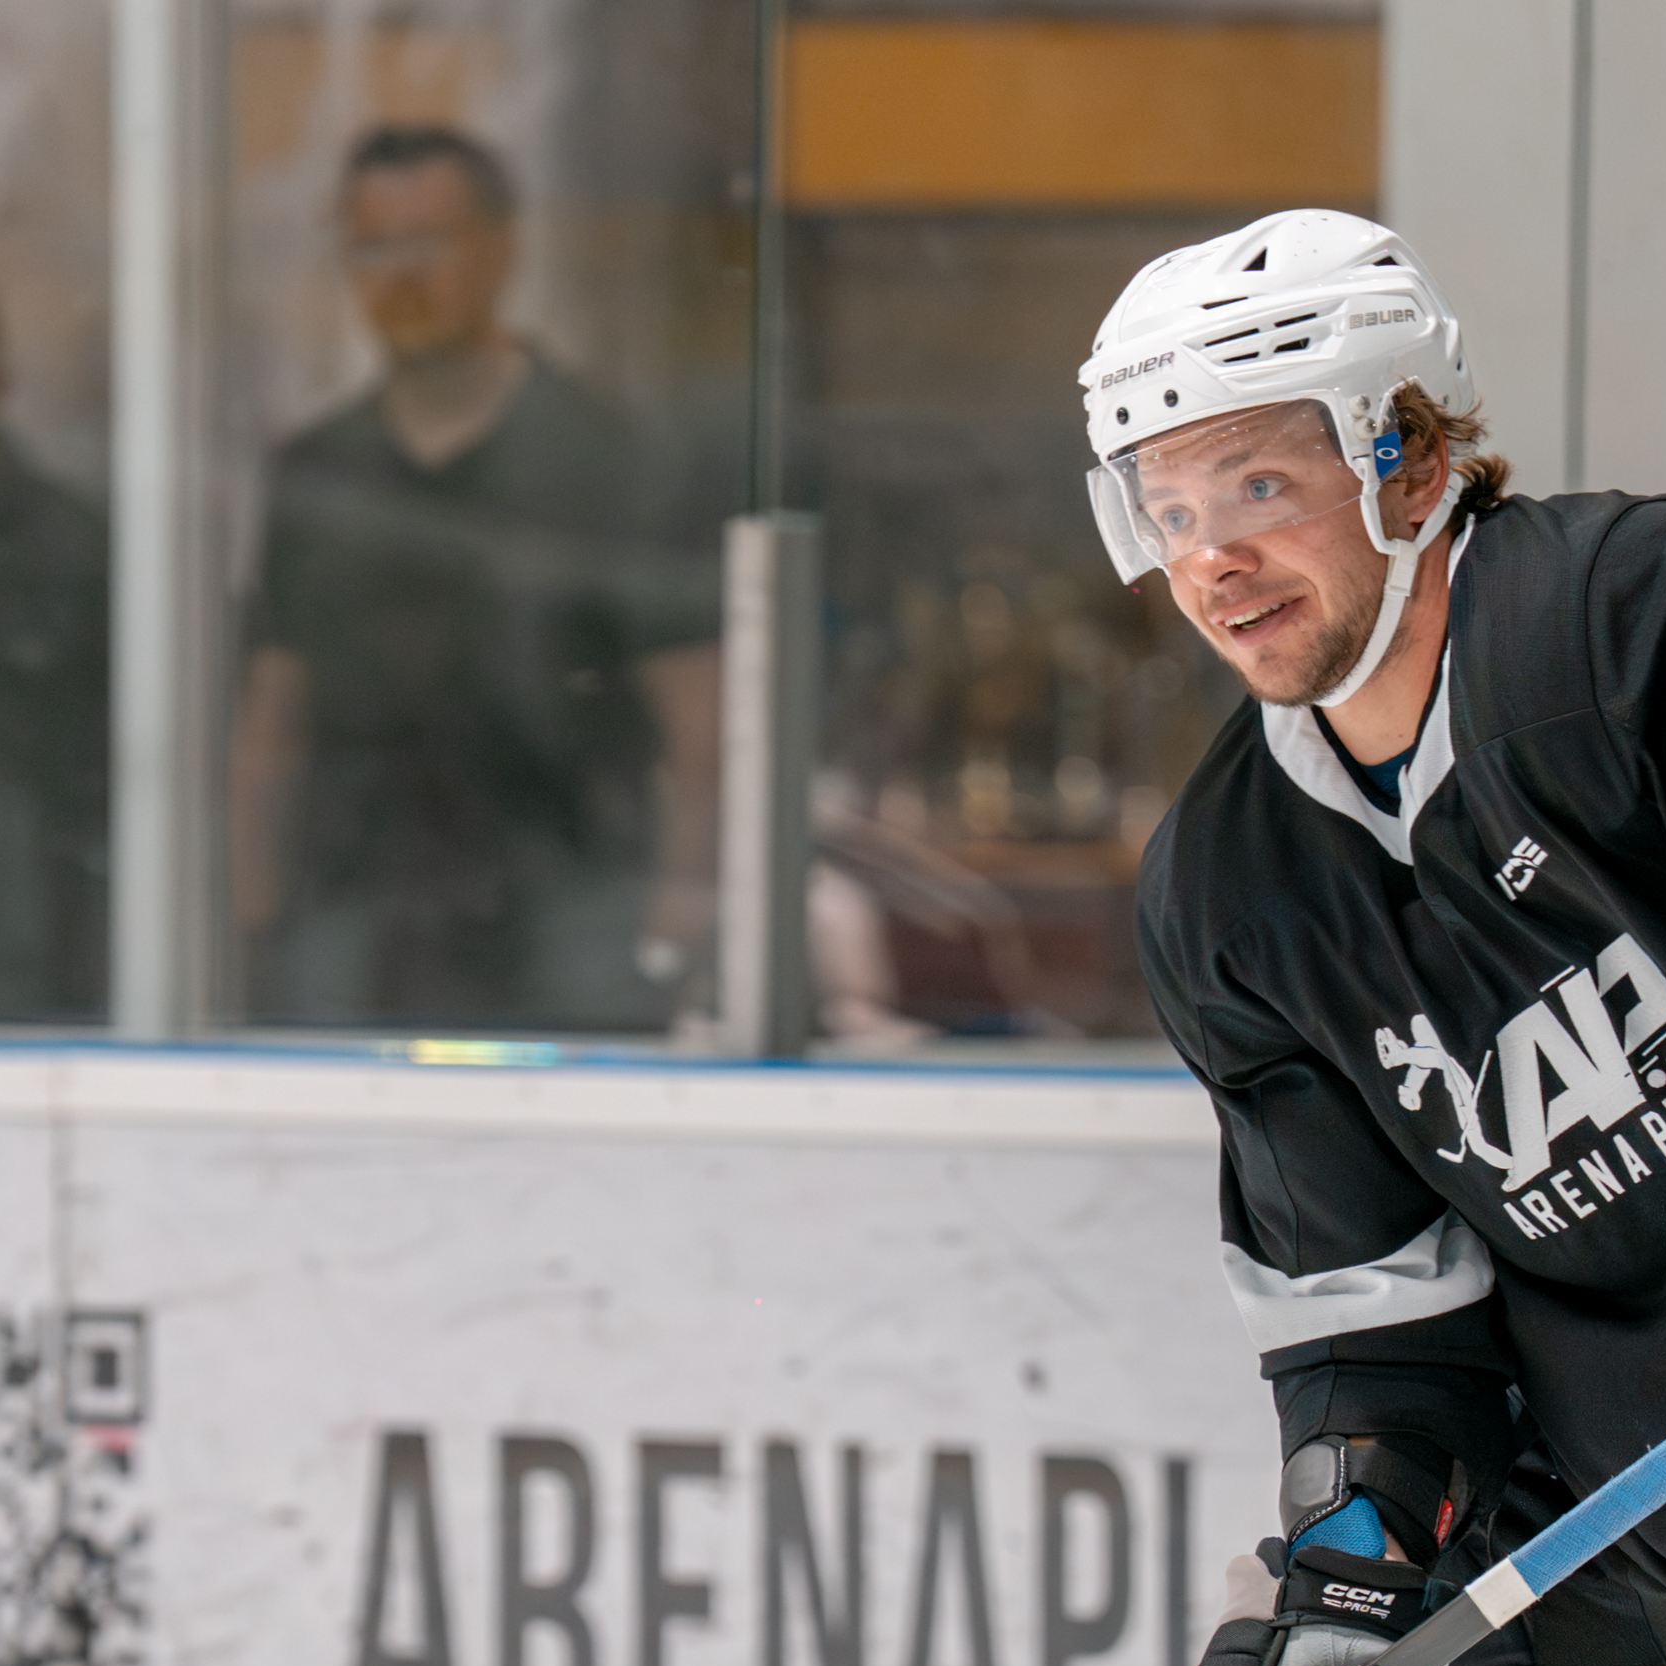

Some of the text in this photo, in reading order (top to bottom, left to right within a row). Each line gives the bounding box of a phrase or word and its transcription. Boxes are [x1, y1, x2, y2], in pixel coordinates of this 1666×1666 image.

[1349, 308, 1417, 330] BAUER
[1101, 351, 1175, 389] BAUER
[1502, 1133, 1653, 1240] ARENA
[1323, 1583, 1396, 1606] CCM
[1342, 1600, 1371, 1613] PRO
